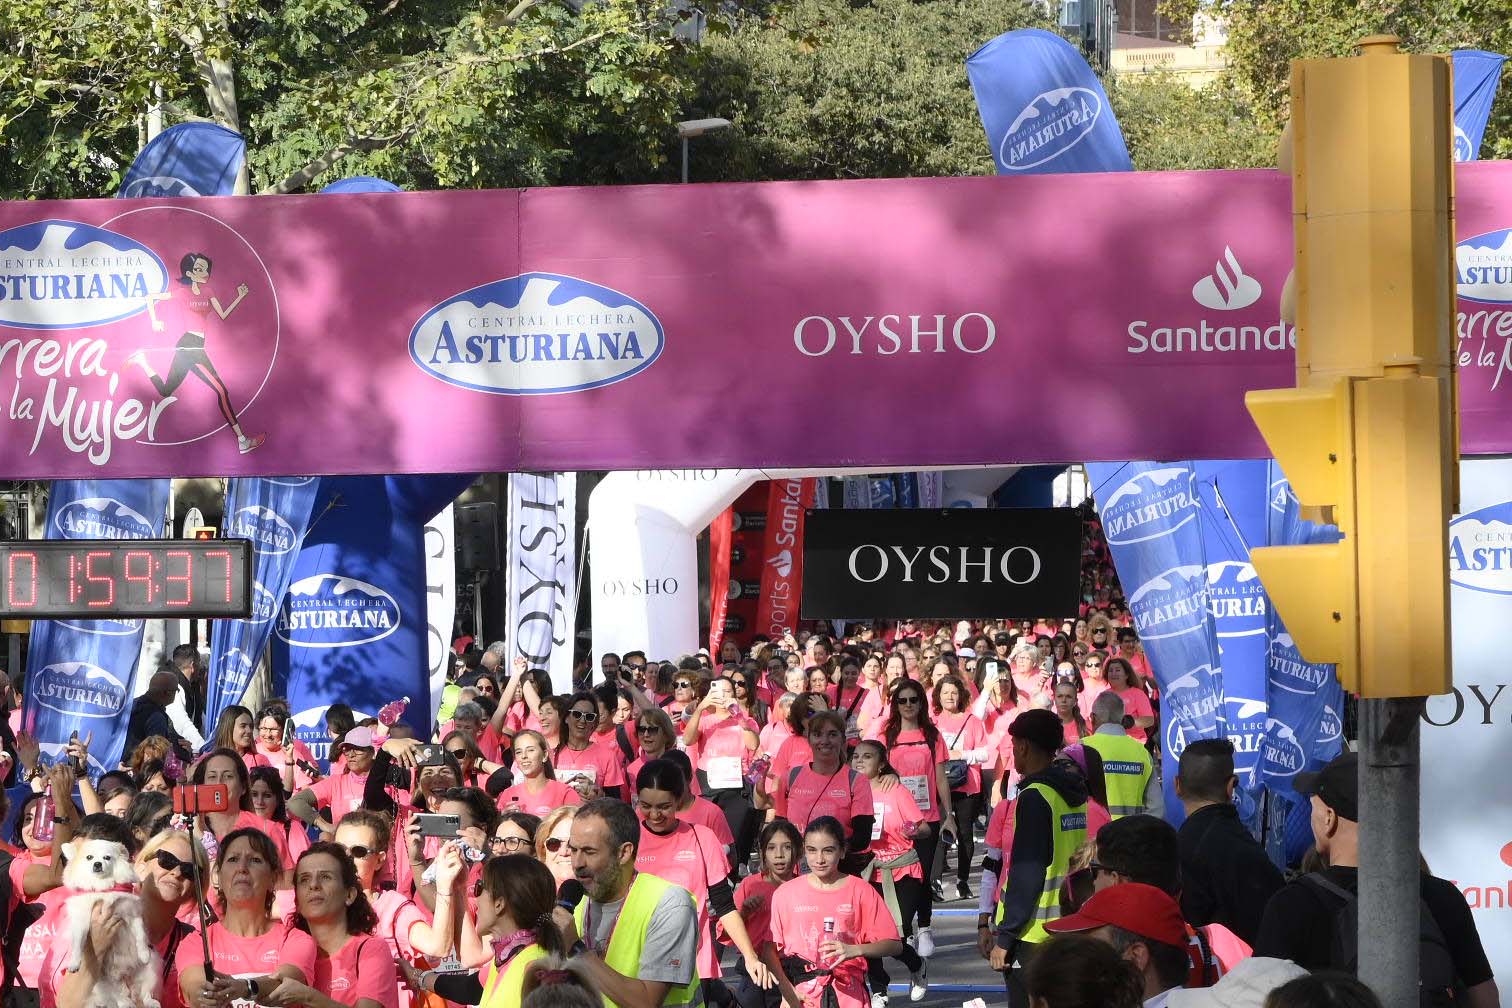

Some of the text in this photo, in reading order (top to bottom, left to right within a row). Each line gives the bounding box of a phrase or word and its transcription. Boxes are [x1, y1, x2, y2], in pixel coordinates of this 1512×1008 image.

[71, 255, 144, 267] LECHERA
[468, 314, 636, 328] CENTRAL LECHERA
[793, 312, 996, 357] OYSHO
[428, 319, 645, 365] ASTURIANA
[1477, 338, 1496, 368] la
[9, 380, 34, 421] la
[28, 373, 178, 466] Mujer
[848, 543, 1042, 585] OYSHO
[603, 578, 679, 595] OYSHO
[278, 606, 392, 632] ASTURIANA
[290, 599, 387, 609] CENTRAL LECHERA
[770, 581, 790, 641] ports
[36, 676, 122, 711] ASTURIANA
[1419, 684, 1512, 727] OY
[1456, 879, 1512, 910] ant
